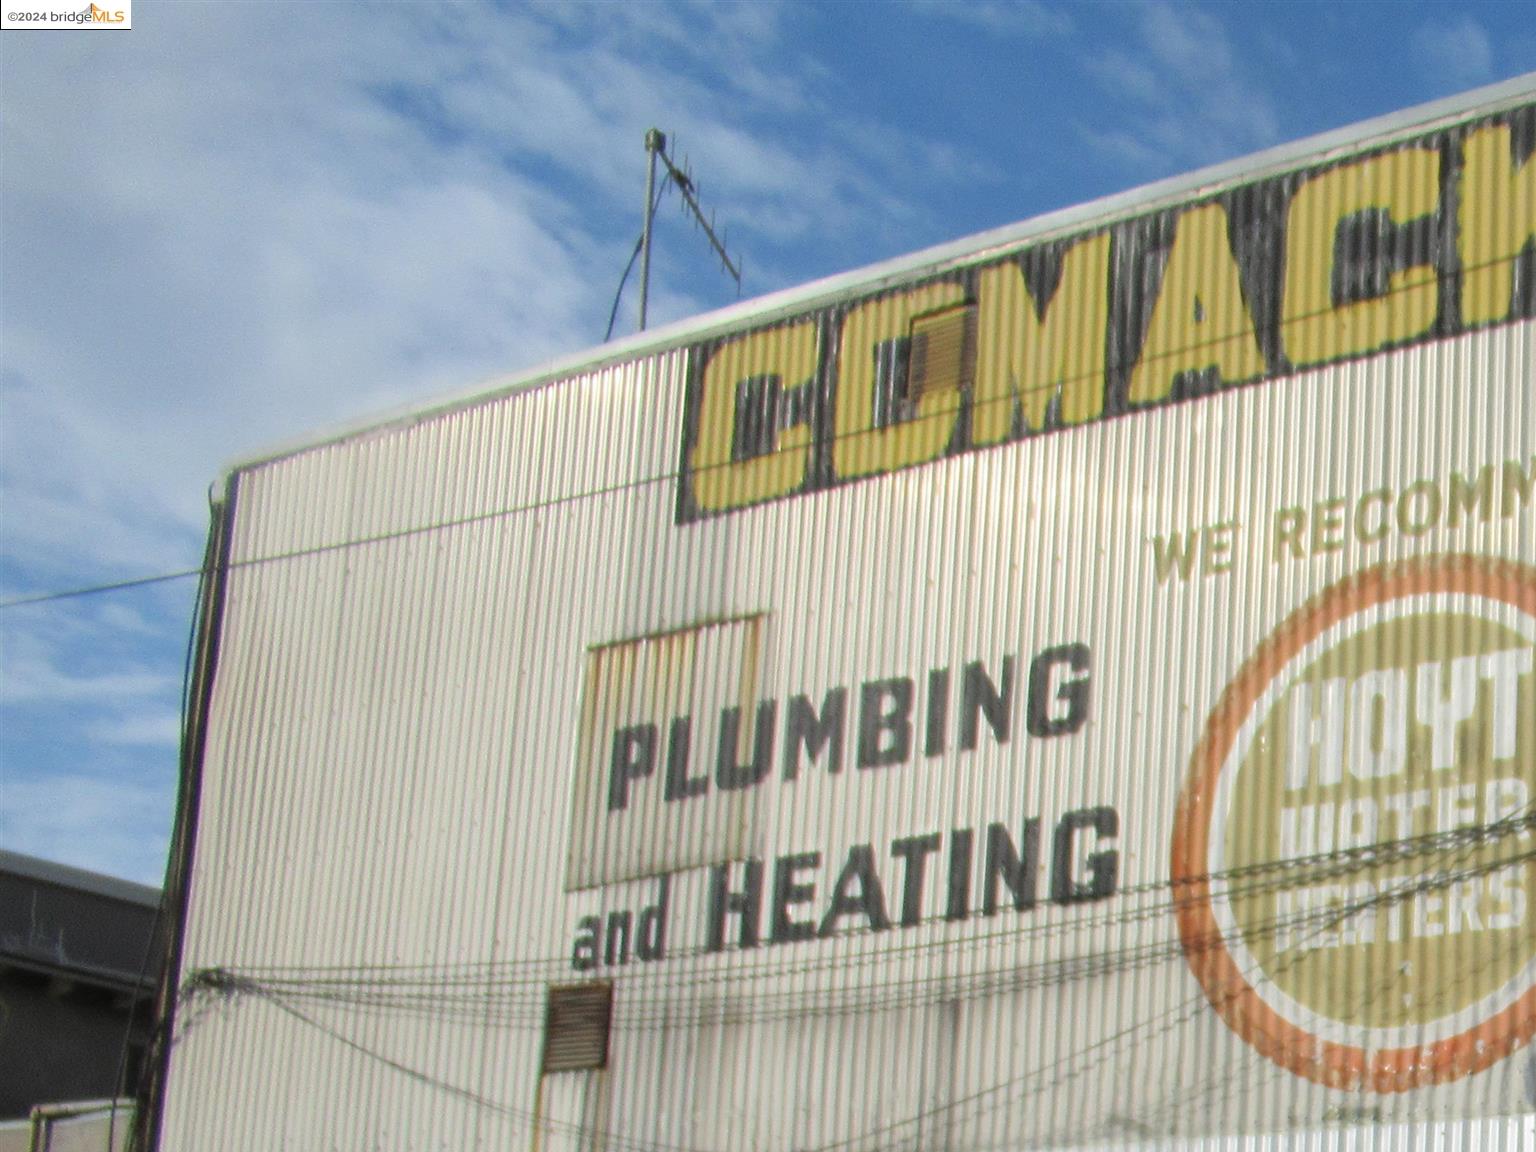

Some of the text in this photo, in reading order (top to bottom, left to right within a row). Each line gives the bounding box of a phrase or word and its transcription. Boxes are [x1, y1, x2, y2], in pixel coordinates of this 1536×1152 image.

[1150, 518, 1236, 588] WE
[606, 641, 1093, 813] PLUMBING
[1285, 647, 1534, 793] HOYT
[572, 805, 1120, 972] and HEATING
